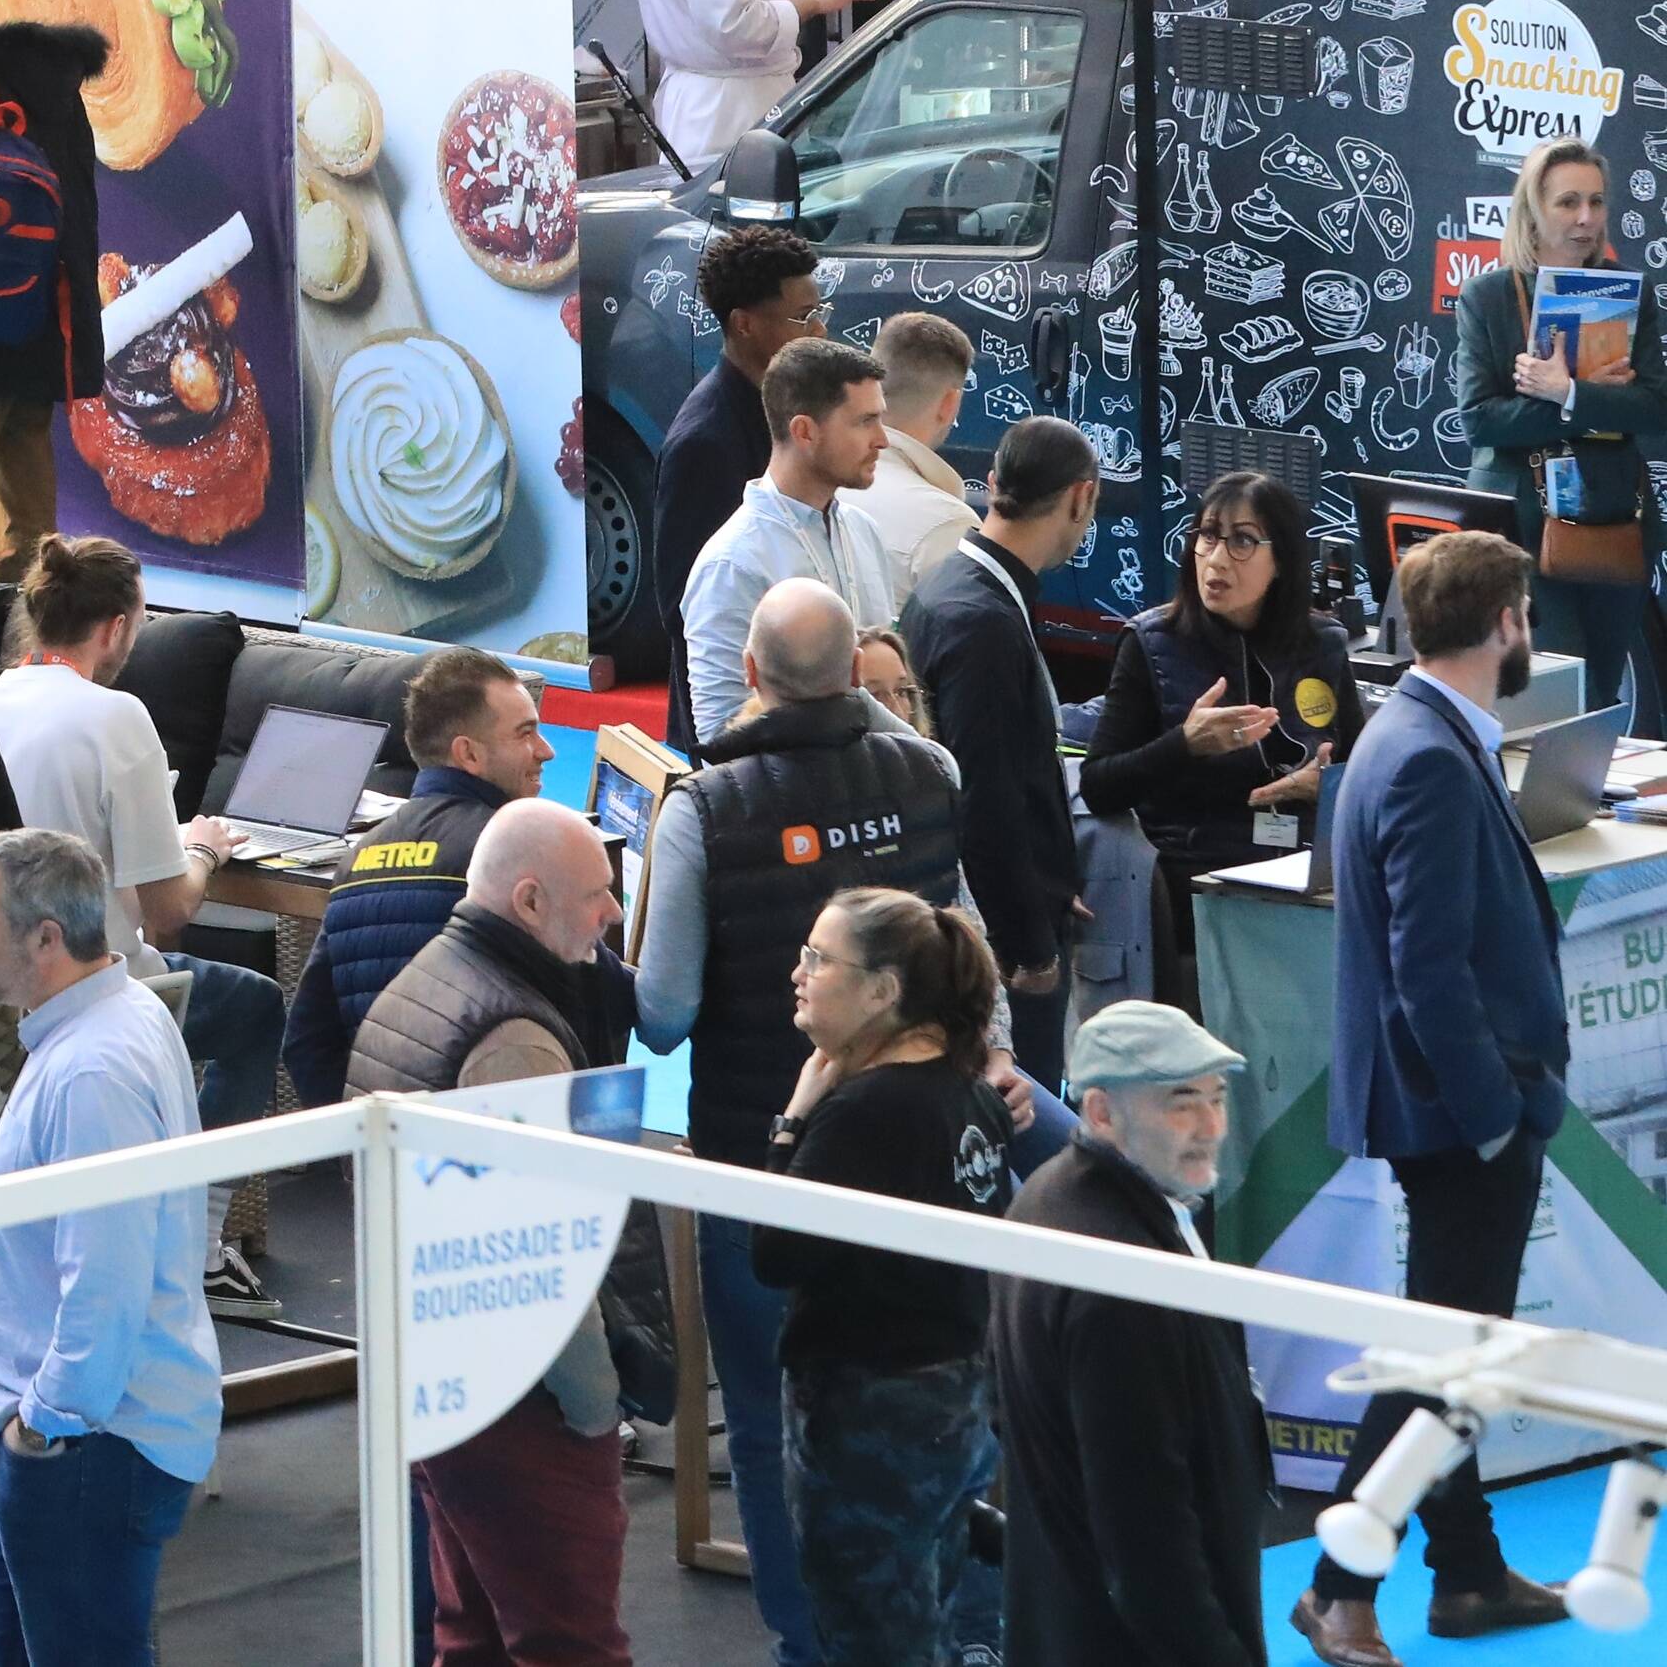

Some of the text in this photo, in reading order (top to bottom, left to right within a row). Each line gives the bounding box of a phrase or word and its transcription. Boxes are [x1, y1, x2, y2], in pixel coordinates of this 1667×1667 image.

[1490, 18, 1567, 51] SOLUTION
[1447, 7, 1623, 112] Snacking
[1457, 78, 1582, 146] Express
[1436, 214, 1467, 241] du
[826, 813, 902, 849] DISH
[351, 840, 438, 871] METRO
[412, 1214, 603, 1278] AMBASSADE DE
[412, 1265, 565, 1323] BOURGOGNE
[413, 1375, 467, 1419] A 25
